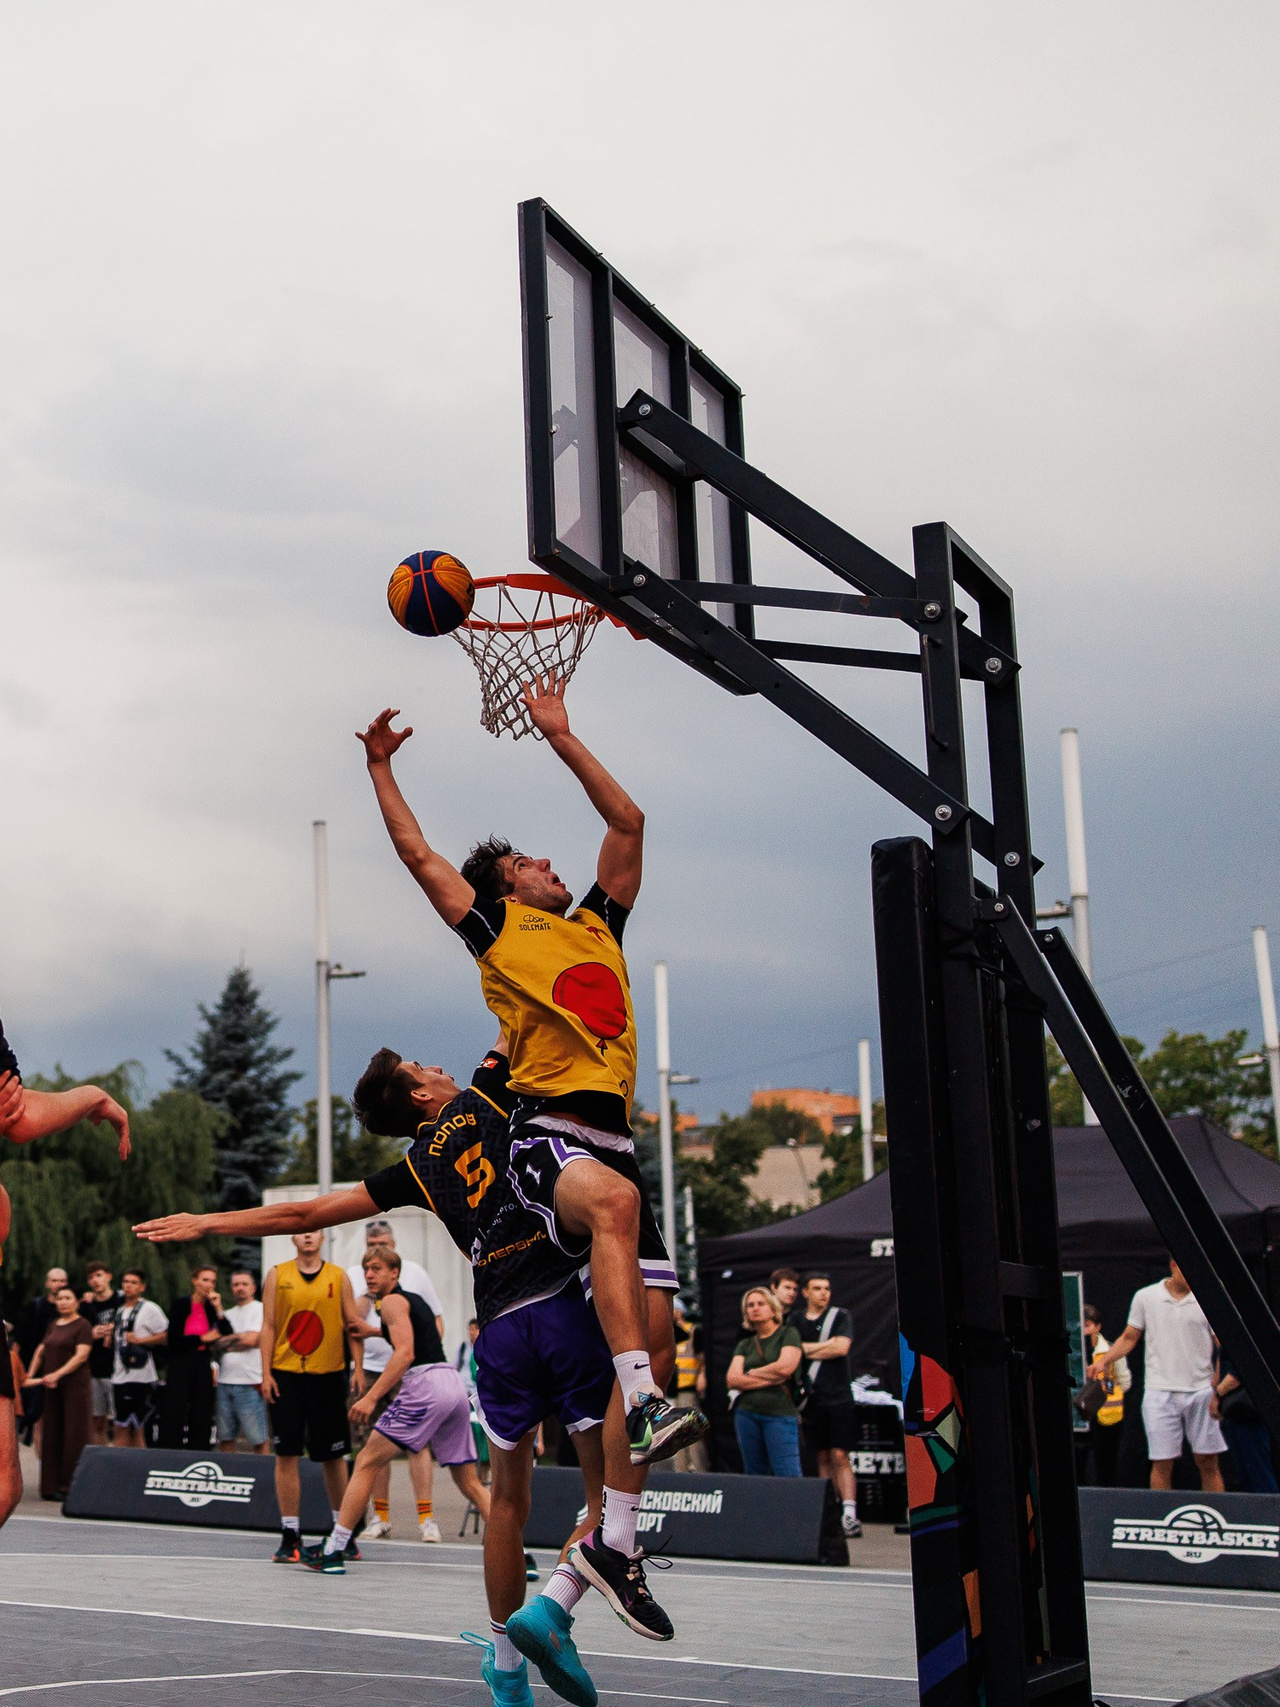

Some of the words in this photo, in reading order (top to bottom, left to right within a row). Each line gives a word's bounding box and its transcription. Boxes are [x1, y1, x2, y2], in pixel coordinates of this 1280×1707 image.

[519, 922, 552, 931] SOLEMATE
[428, 1113, 477, 1157] ПОПОВ
[454, 1141, 496, 1209] 5
[145, 1477, 254, 1496] STREETBASKET
[640, 1489, 723, 1514] СКОВСКИЙ
[636, 1512, 666, 1533] ОРТ
[1112, 1526, 1280, 1549] STREETBASKET
